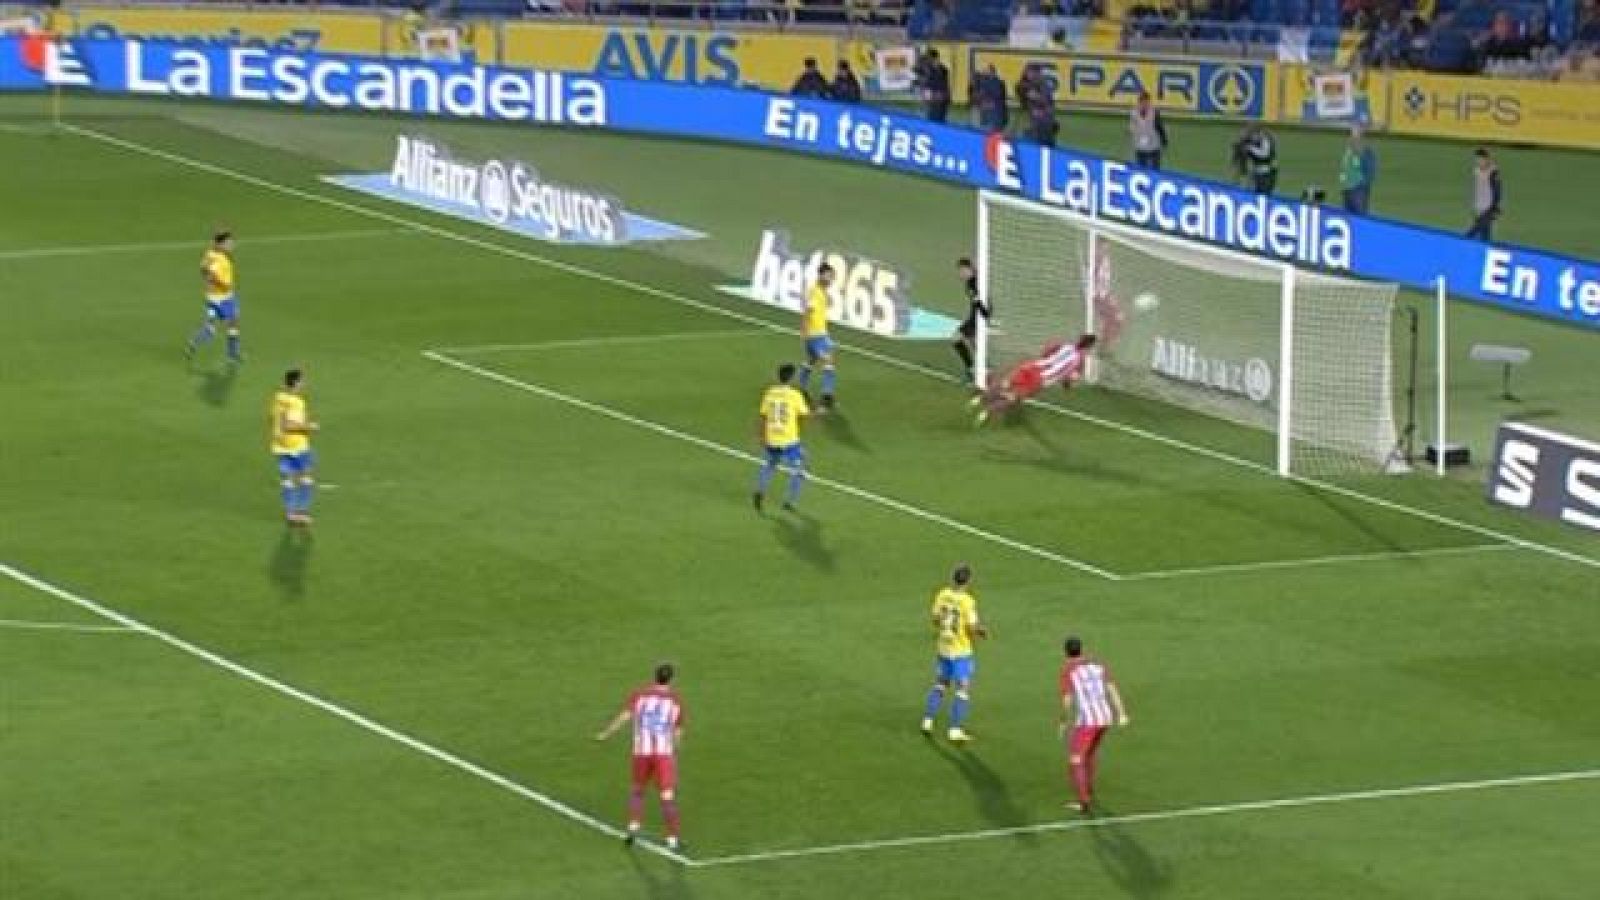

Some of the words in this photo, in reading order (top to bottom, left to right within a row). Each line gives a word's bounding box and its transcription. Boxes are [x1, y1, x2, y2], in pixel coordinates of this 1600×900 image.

[126, 42, 210, 96] La
[230, 46, 607, 124] Escandella
[593, 30, 740, 87] AVIS
[765, 98, 818, 142] En
[837, 107, 969, 173] tejas...
[1431, 91, 1521, 126] HPS
[391, 134, 480, 207] Allianz
[511, 163, 617, 241] Seguros
[1041, 146, 1090, 210] La
[1102, 159, 1351, 269] Escandella
[753, 229, 898, 336] bet365
[1482, 248, 1538, 301] En
